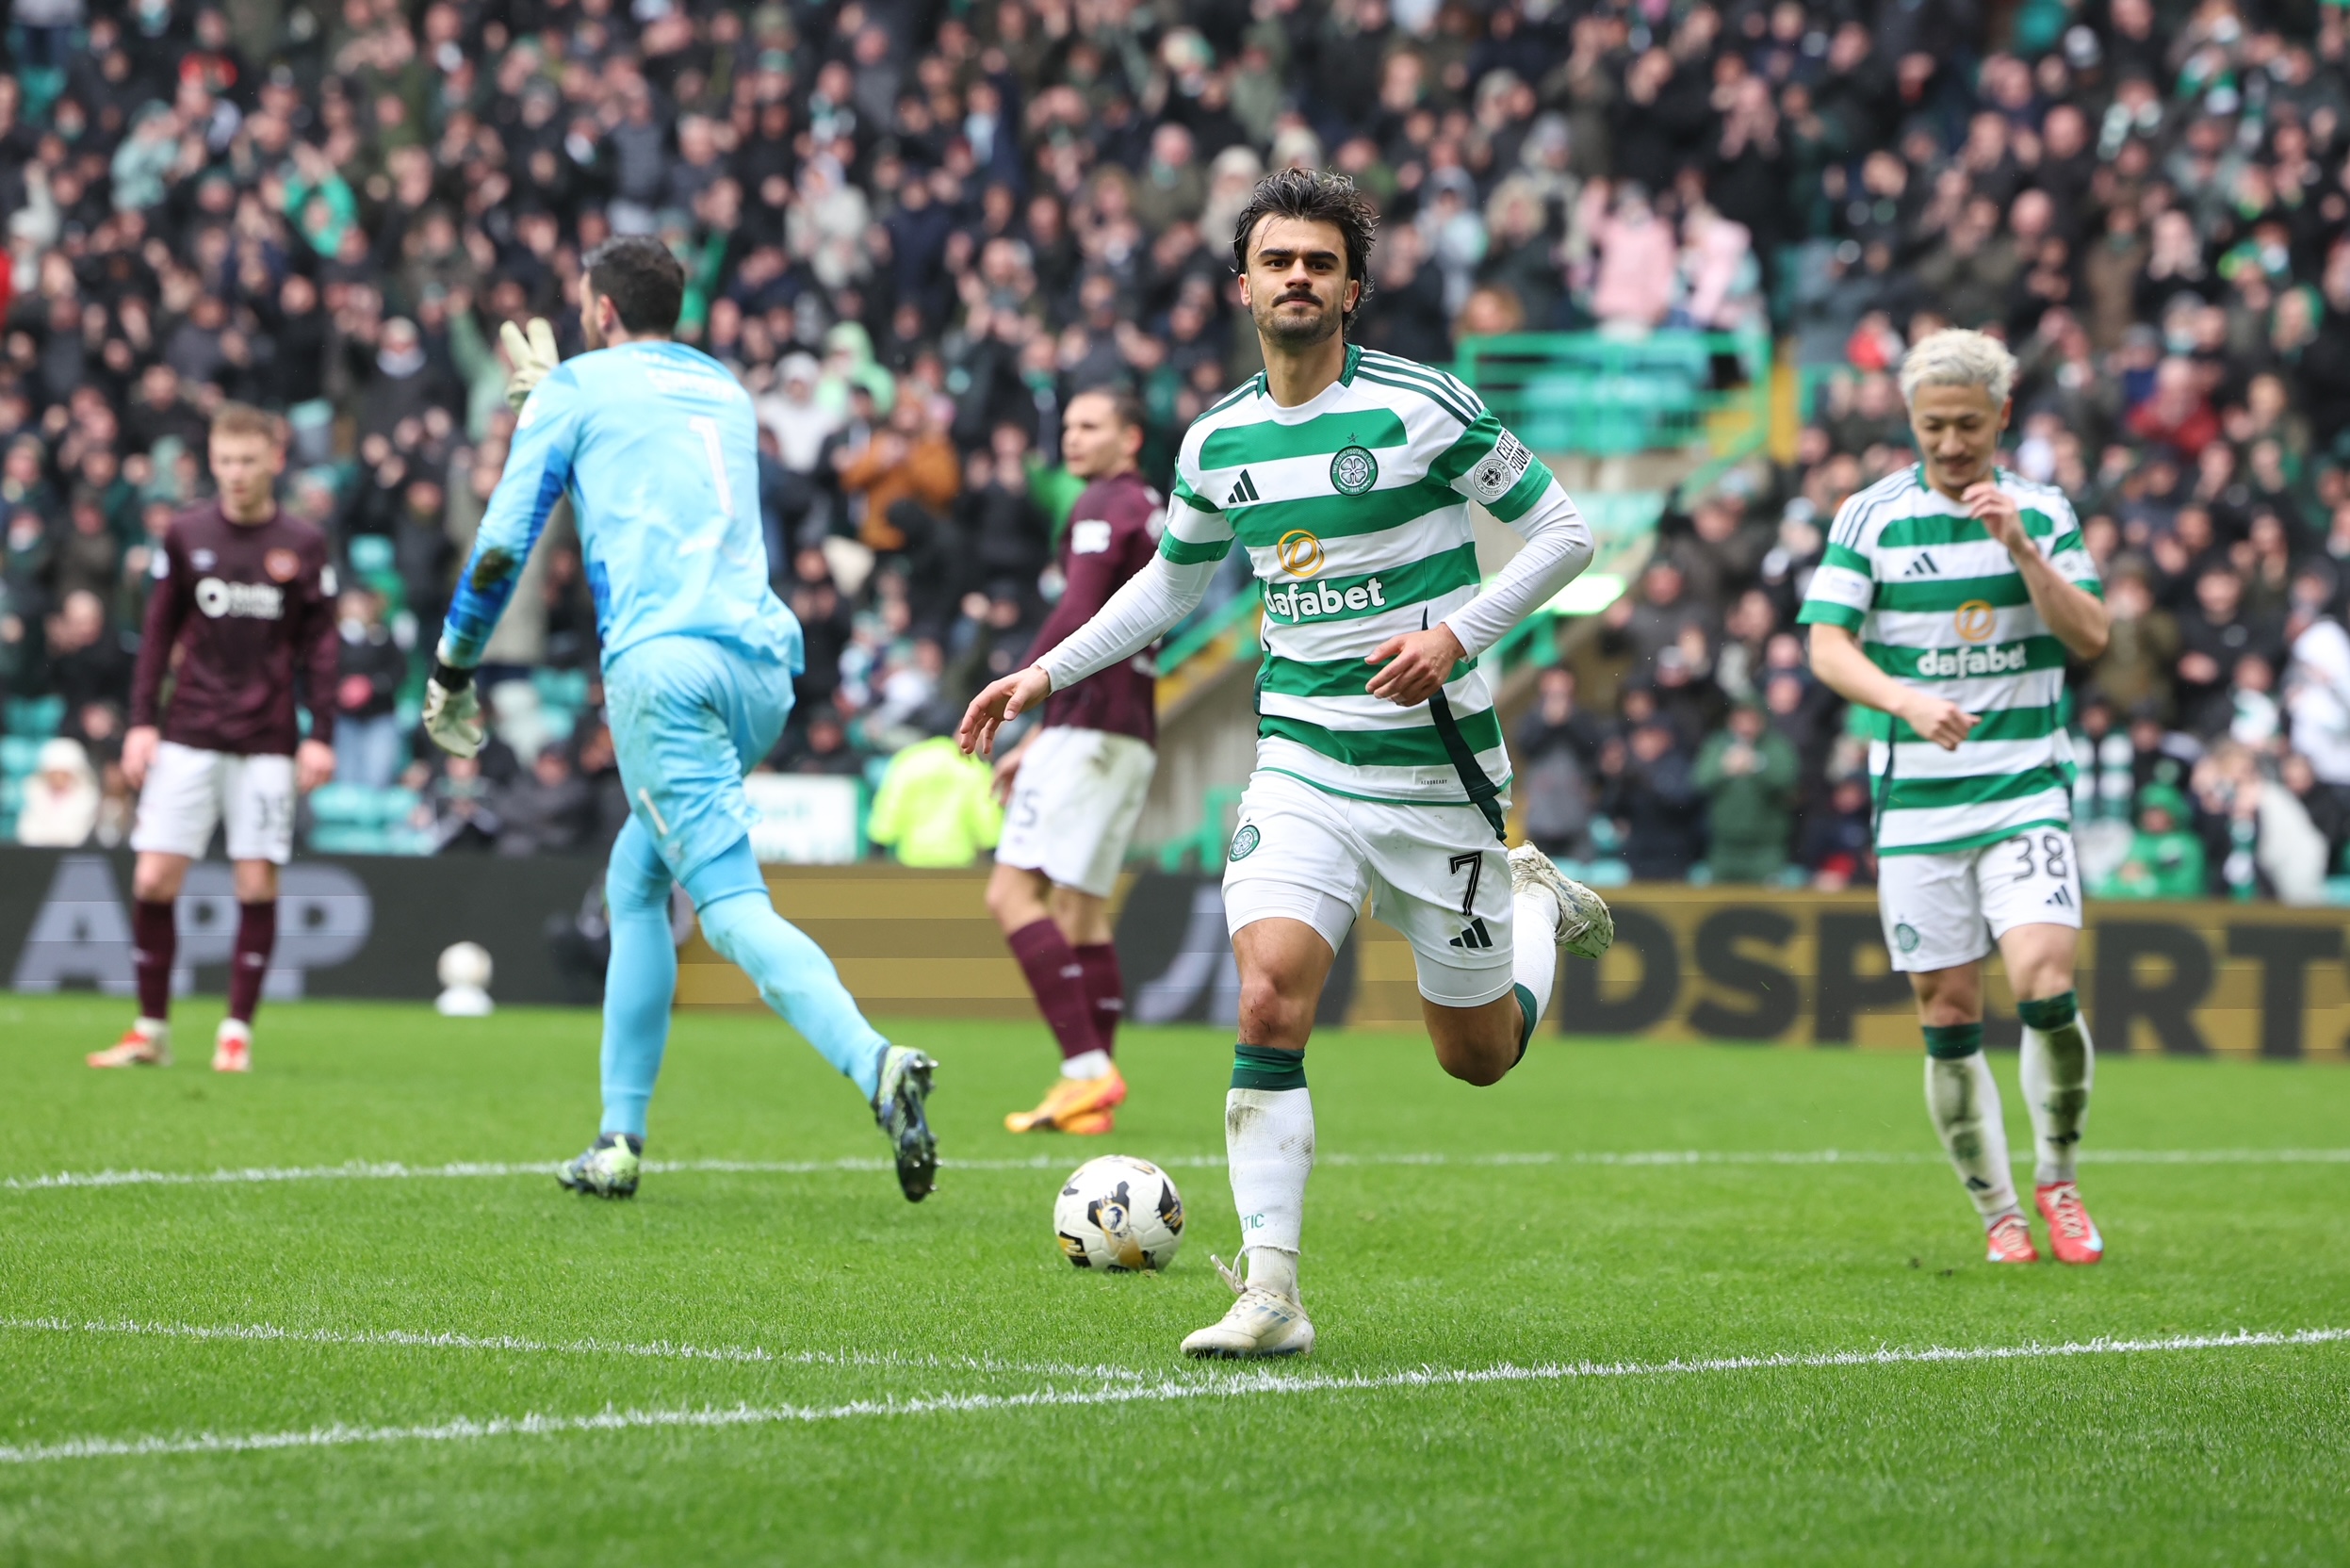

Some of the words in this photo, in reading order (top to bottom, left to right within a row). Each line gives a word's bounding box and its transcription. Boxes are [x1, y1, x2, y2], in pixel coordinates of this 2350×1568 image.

[688, 415, 735, 517] 1
[1264, 577, 1386, 623] dafabet
[1917, 643, 2027, 678] dafabet
[1448, 851, 1484, 917] 7
[2009, 835, 2067, 882] 38
[12, 854, 371, 1001] APP
